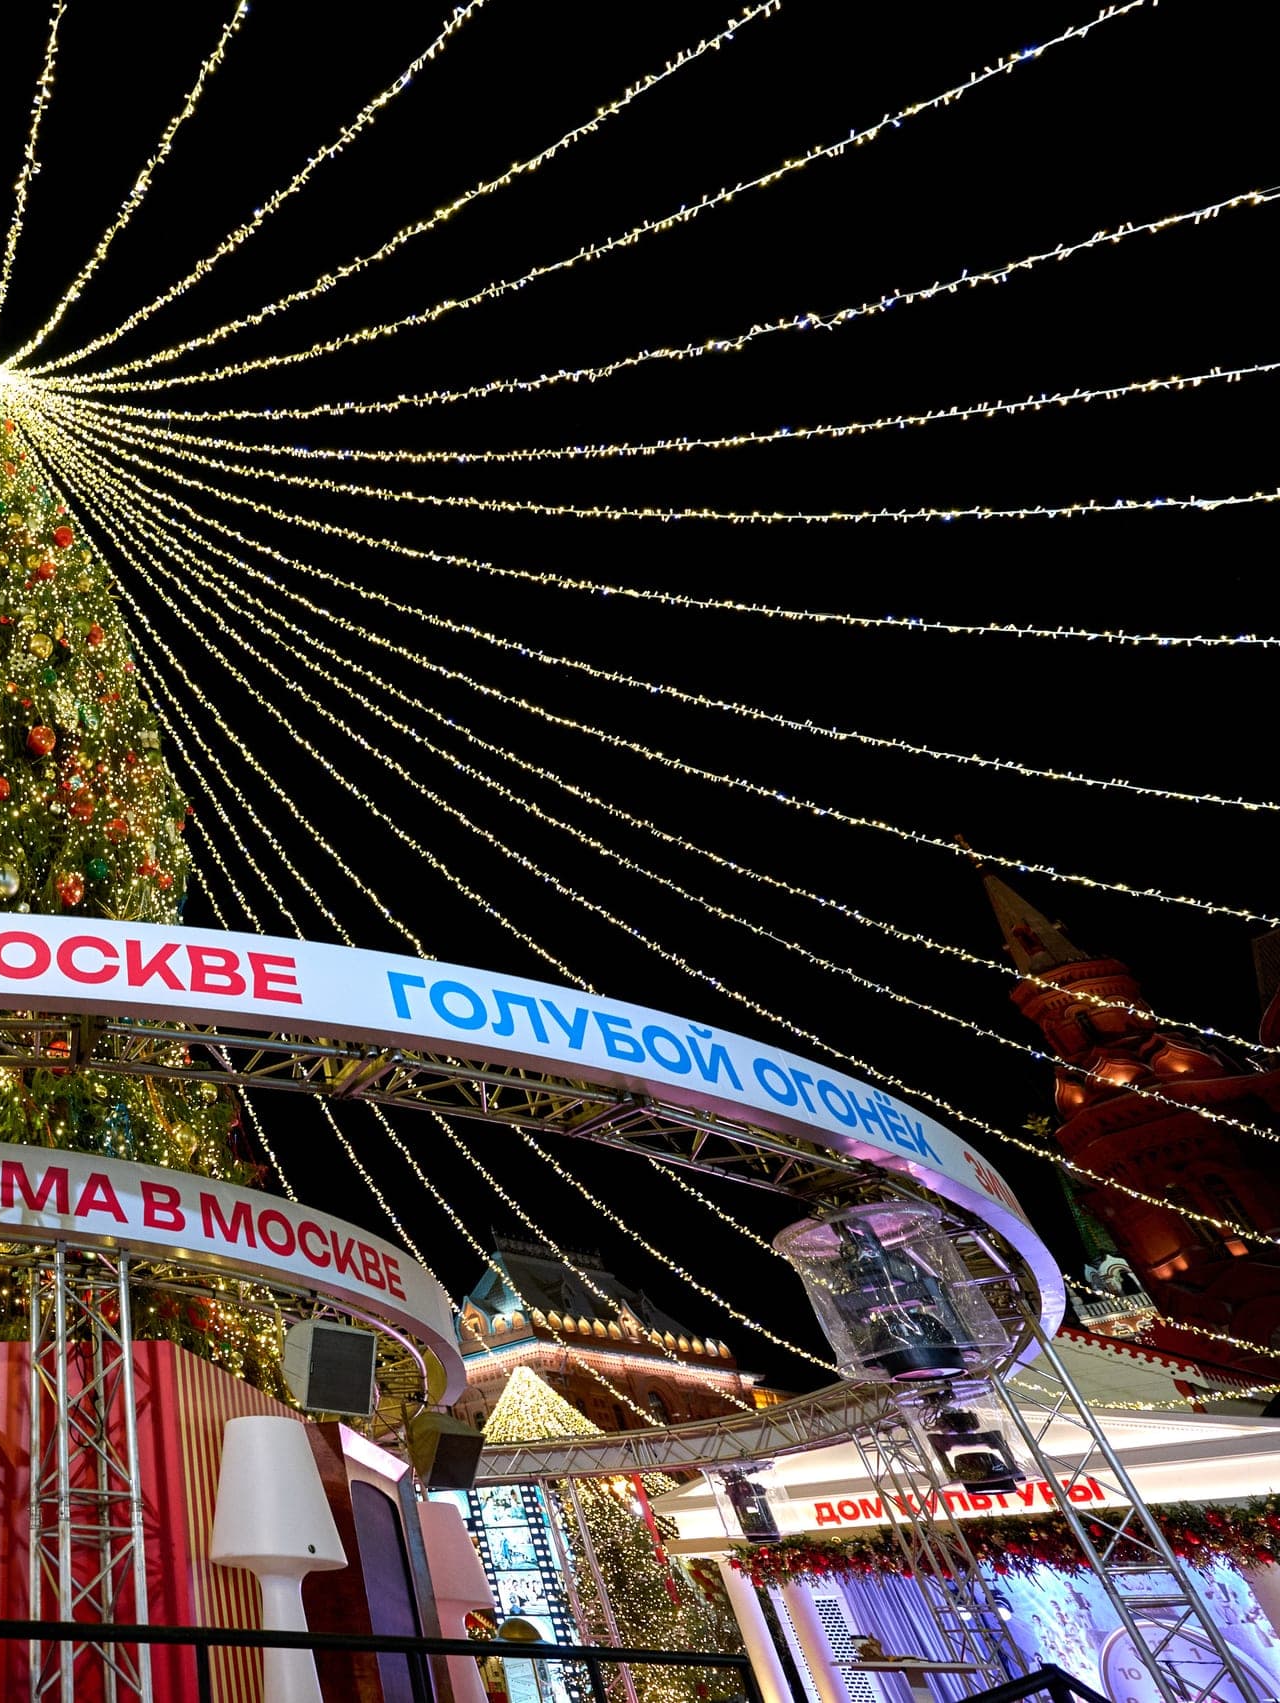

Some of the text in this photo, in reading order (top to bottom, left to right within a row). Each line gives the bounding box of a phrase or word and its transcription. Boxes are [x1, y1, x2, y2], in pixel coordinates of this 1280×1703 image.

[386, 970, 944, 1166] ГОЛУБОЙ ОГОНЁК
[140, 1181, 186, 1232] В
[199, 1191, 408, 1302] МОСКВЕ
[813, 1497, 884, 1527] ДОМ
[1118, 1667, 1142, 1681] 10
